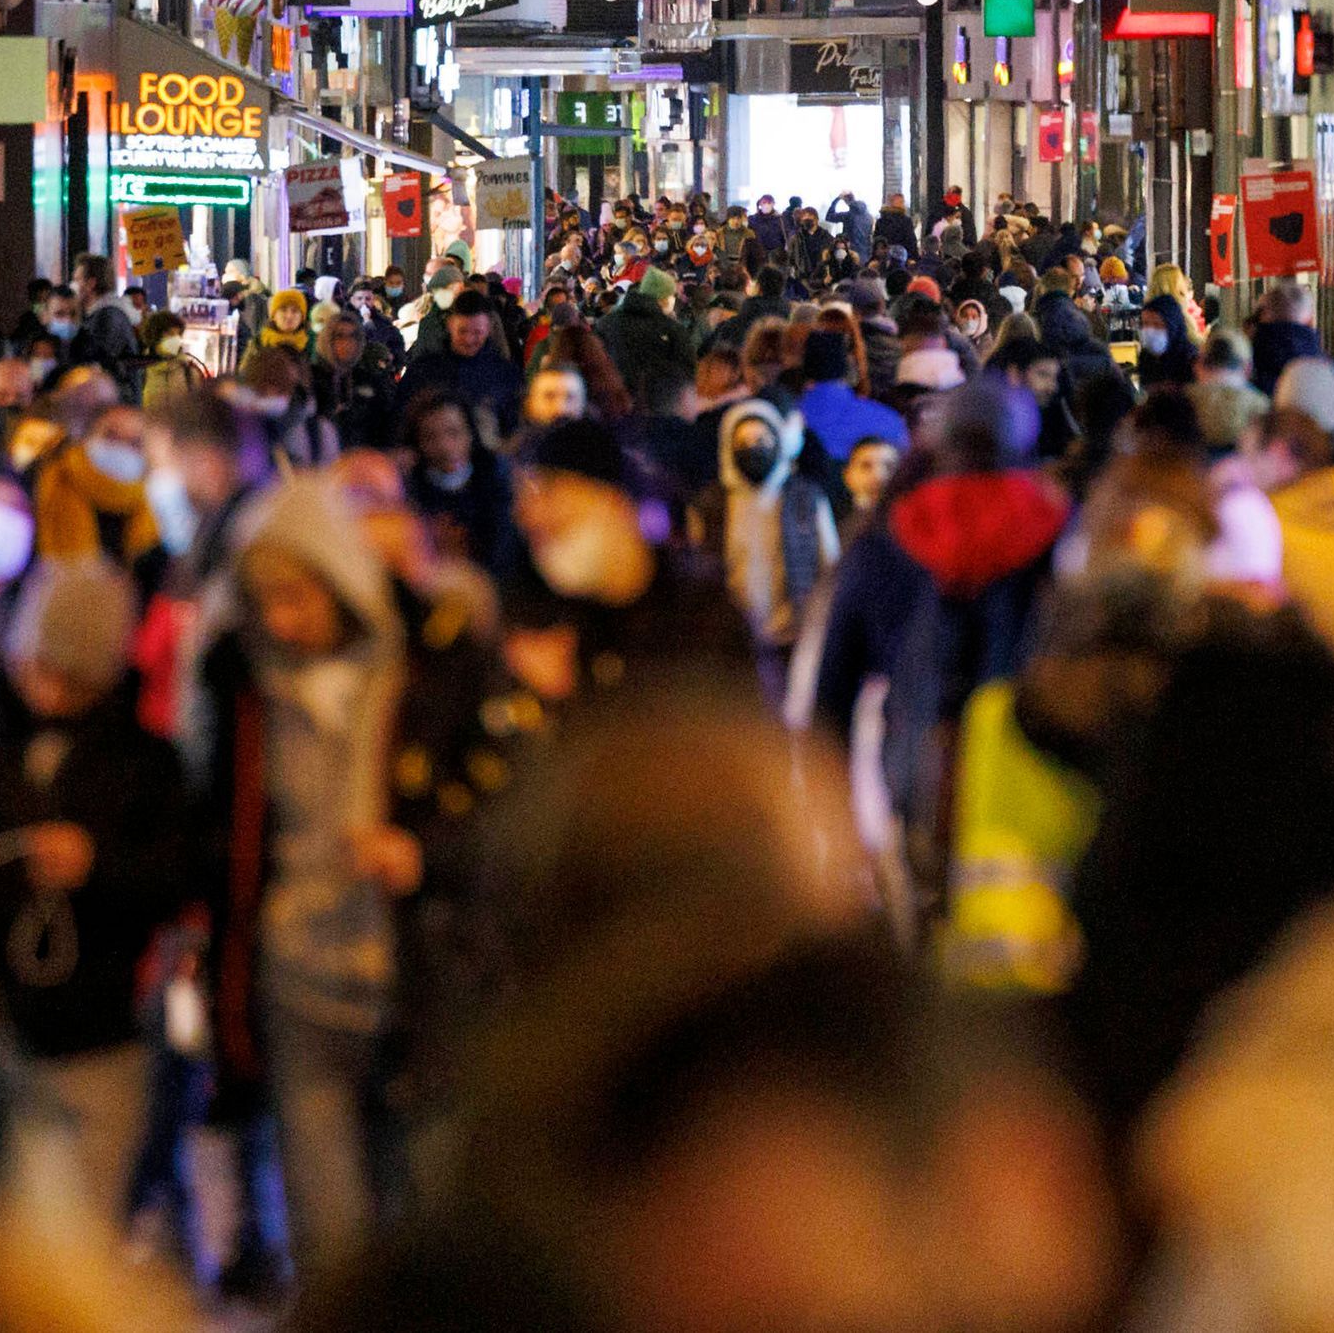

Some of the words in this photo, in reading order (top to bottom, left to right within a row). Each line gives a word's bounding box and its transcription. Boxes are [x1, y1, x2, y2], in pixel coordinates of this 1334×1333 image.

[139, 72, 246, 107] FOOD
[119, 101, 263, 138] LOUNGE
[285, 166, 341, 185] PIZZA
